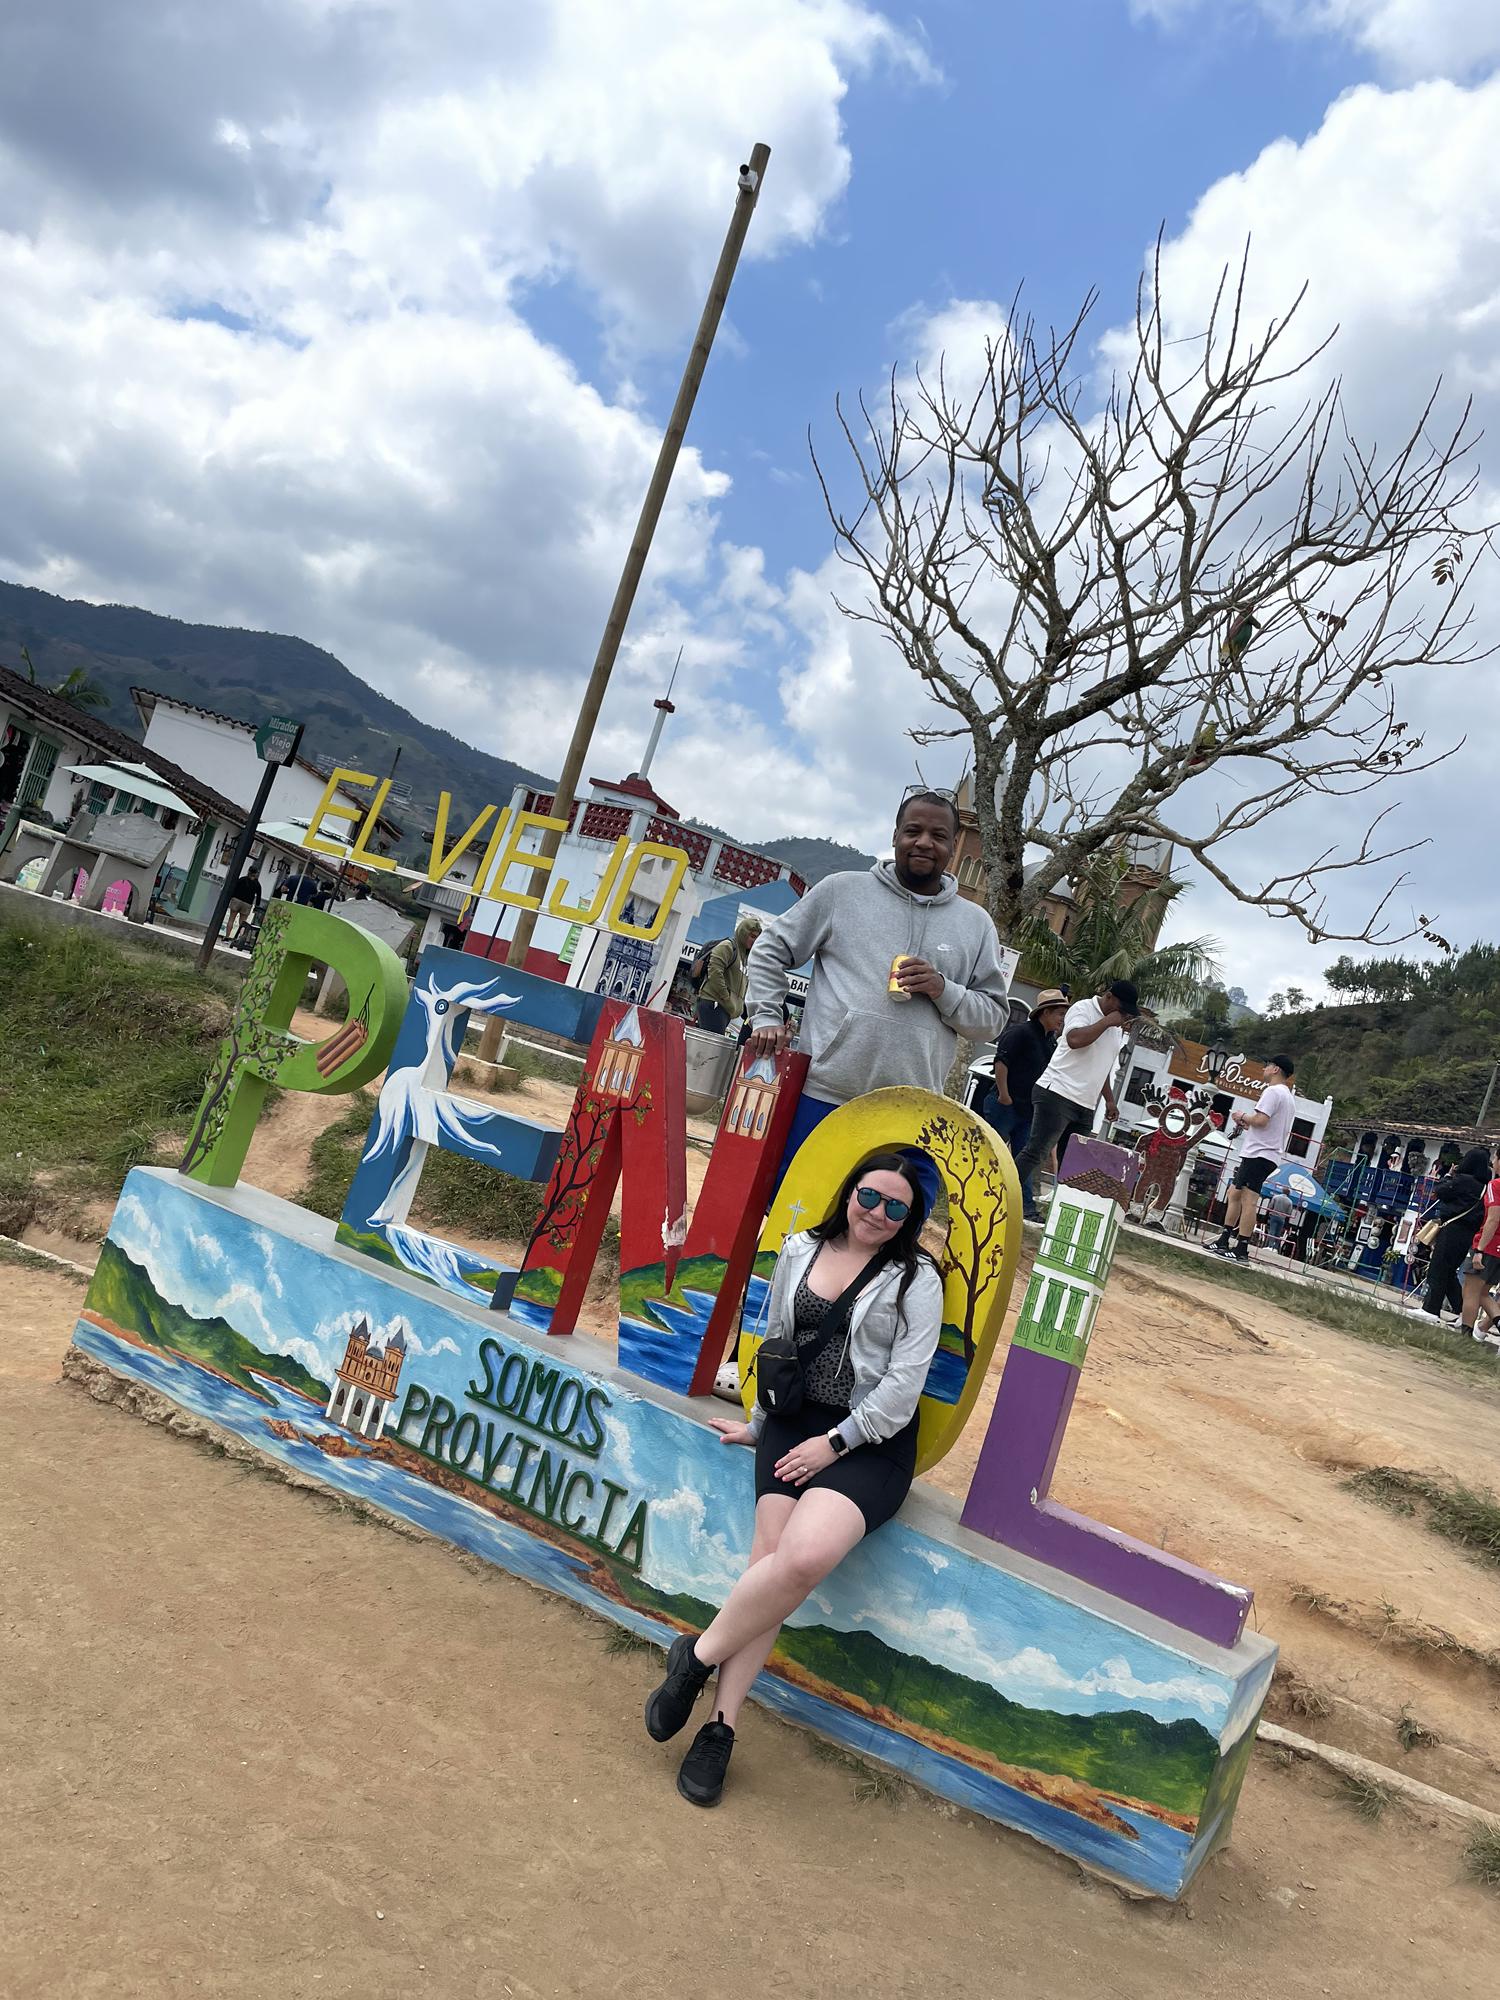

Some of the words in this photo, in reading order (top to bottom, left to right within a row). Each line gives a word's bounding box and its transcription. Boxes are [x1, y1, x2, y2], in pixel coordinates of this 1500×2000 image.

[269, 717, 299, 734] Mirador
[271, 735, 291, 749] Viejo
[302, 767, 398, 871] EL
[427, 791, 690, 941] VIEJO
[465, 1338, 613, 1455] SOMOS
[396, 1383, 648, 1572] PROVINCIA
